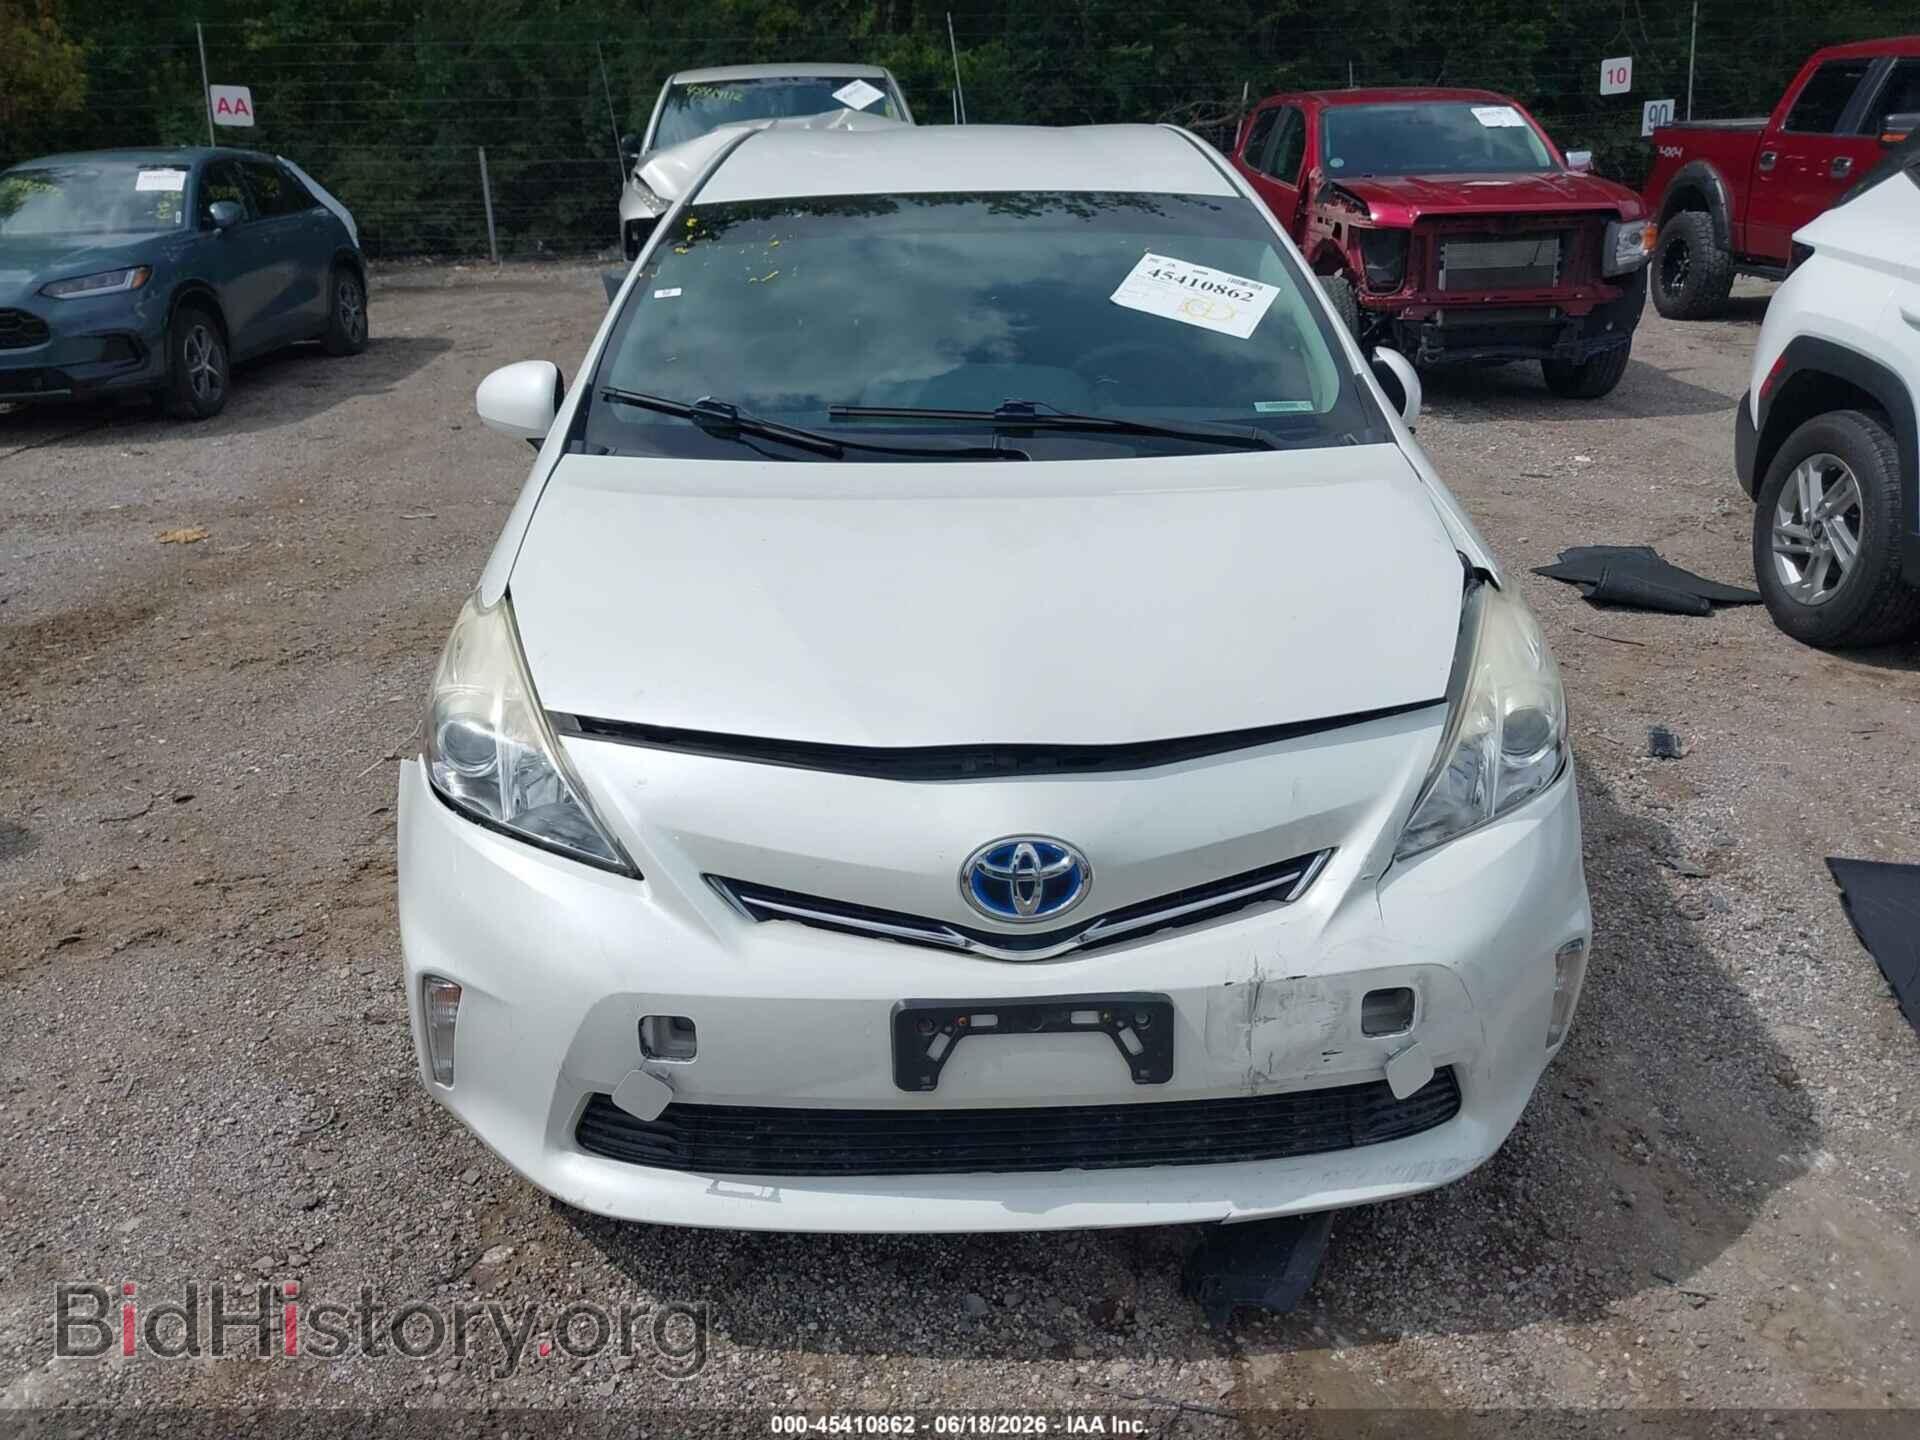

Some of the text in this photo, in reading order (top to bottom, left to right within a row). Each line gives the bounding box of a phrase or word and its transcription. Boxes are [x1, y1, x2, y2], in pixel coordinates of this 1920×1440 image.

[1607, 67, 1627, 85] 10
[217, 96, 250, 116] AA
[1147, 268, 1255, 302] 45410862
